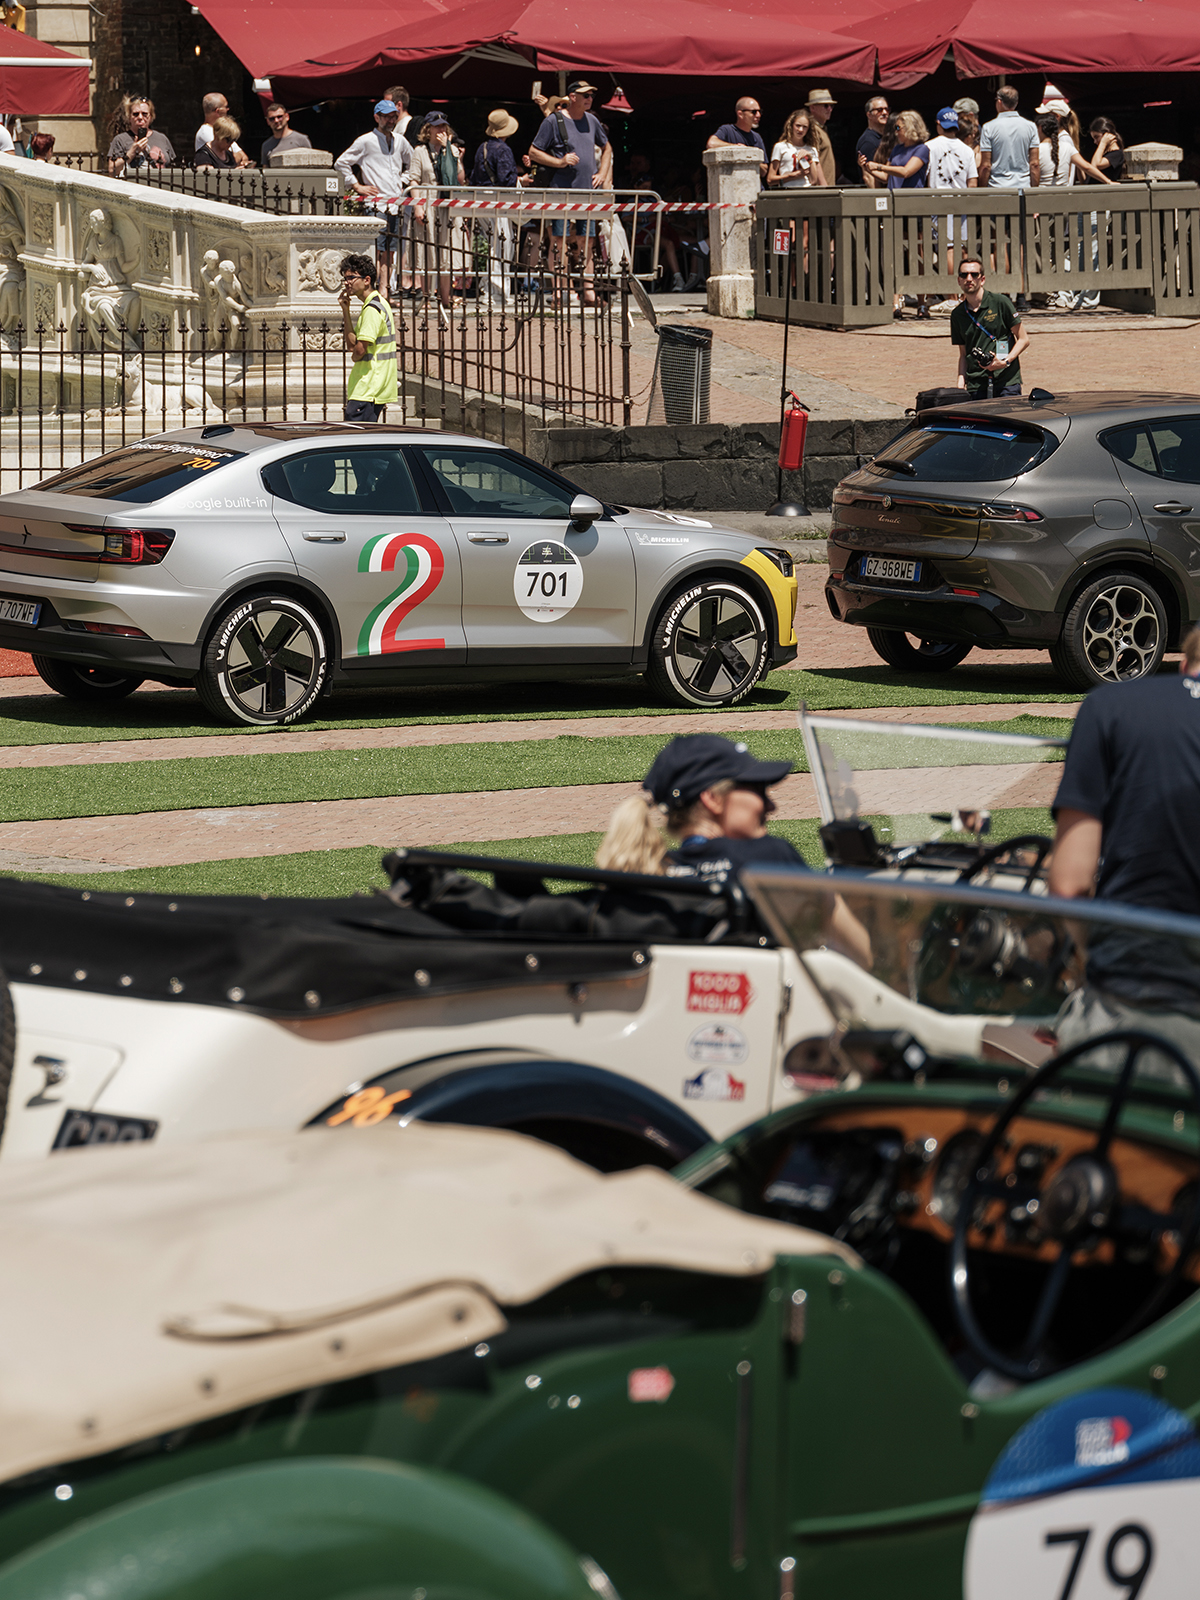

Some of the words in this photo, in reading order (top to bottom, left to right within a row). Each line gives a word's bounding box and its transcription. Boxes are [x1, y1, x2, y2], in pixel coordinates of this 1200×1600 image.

[328, 181, 337, 189] 23
[182, 457, 220, 471] 701
[224, 496, 268, 509] built-in
[357, 532, 446, 656] 2
[526, 571, 568, 597] 701
[665, 586, 702, 636] MICHELIN
[284, 675, 323, 724] MICHELIN
[326, 1086, 413, 1128] 96
[1045, 1521, 1155, 1600] 79
